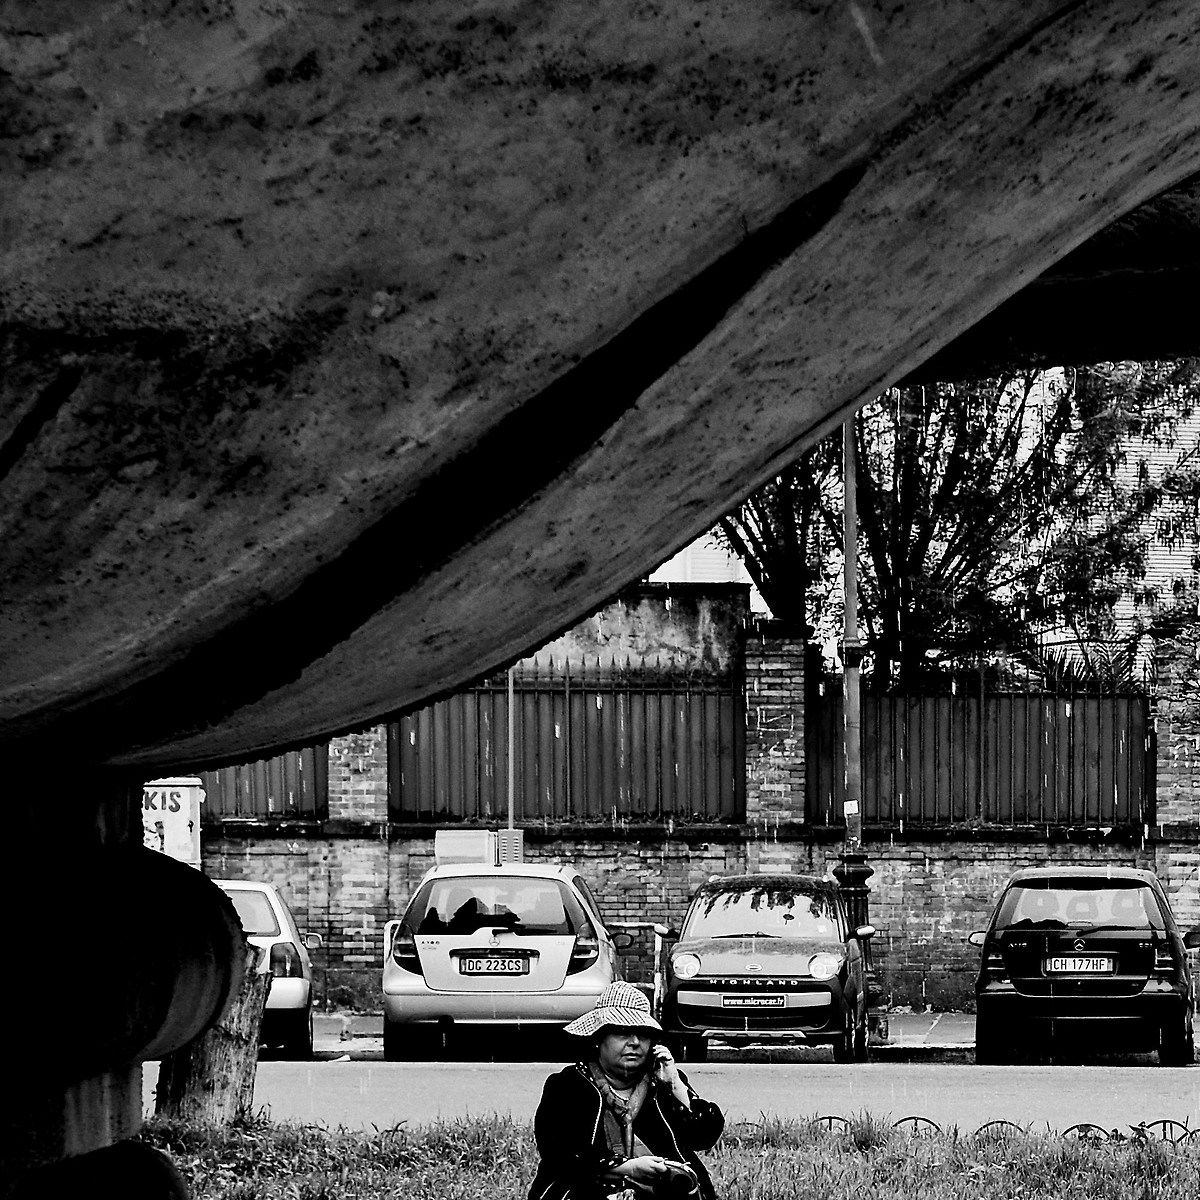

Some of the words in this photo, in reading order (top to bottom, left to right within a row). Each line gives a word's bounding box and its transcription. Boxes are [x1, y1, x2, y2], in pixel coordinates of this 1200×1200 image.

[467, 959, 482, 971] DG
[485, 959, 522, 971] 223CS
[1053, 958, 1067, 970] CH
[1072, 958, 1107, 970] 177HF
